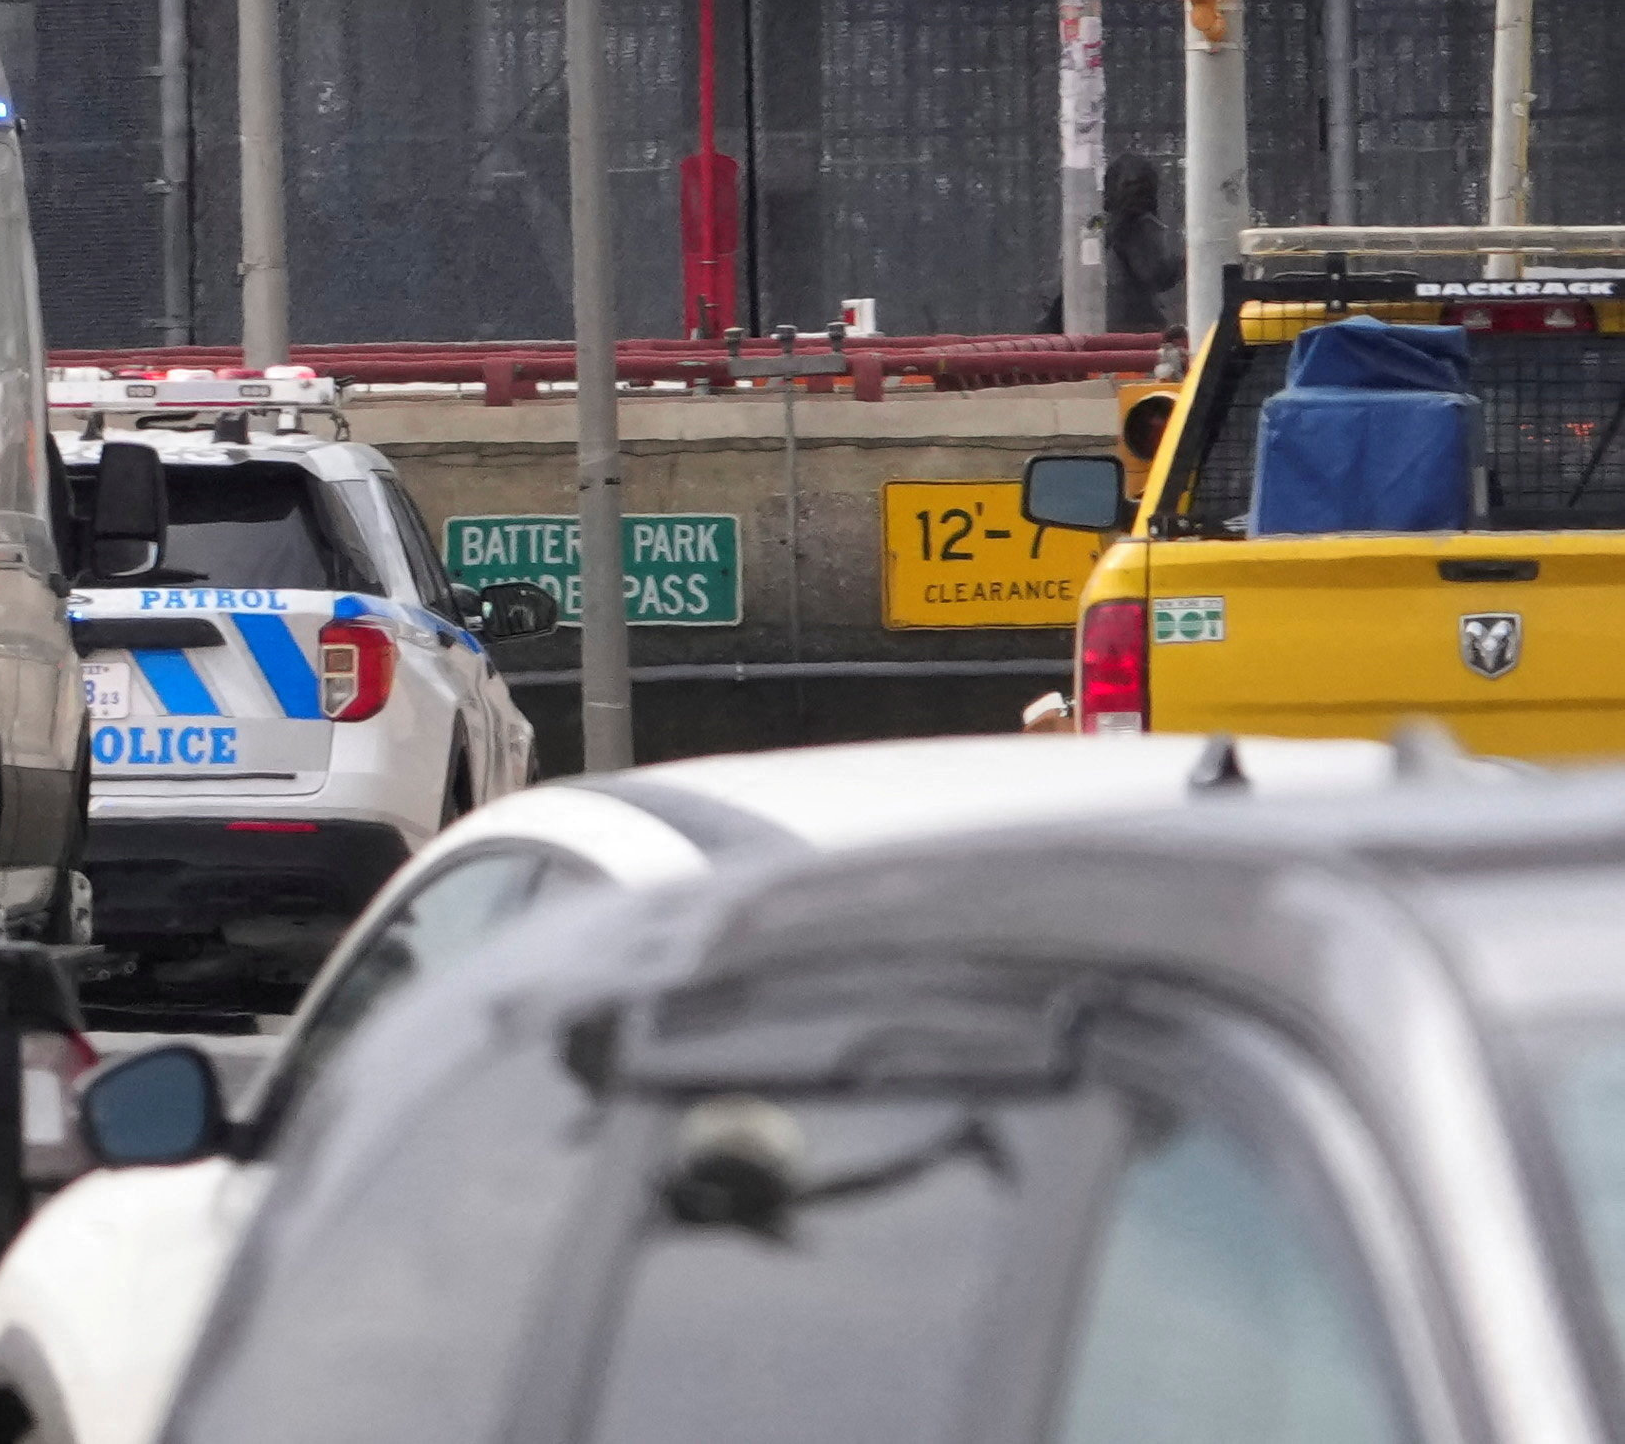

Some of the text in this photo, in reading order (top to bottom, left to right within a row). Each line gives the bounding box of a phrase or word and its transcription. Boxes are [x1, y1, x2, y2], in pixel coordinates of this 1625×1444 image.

[1415, 281, 1615, 297] BACKRACK
[461, 523, 719, 565] BATTER PARK
[140, 590, 287, 610] PATROL
[925, 579, 1074, 604] CLEARANCE
[91, 725, 237, 764] OLICE
